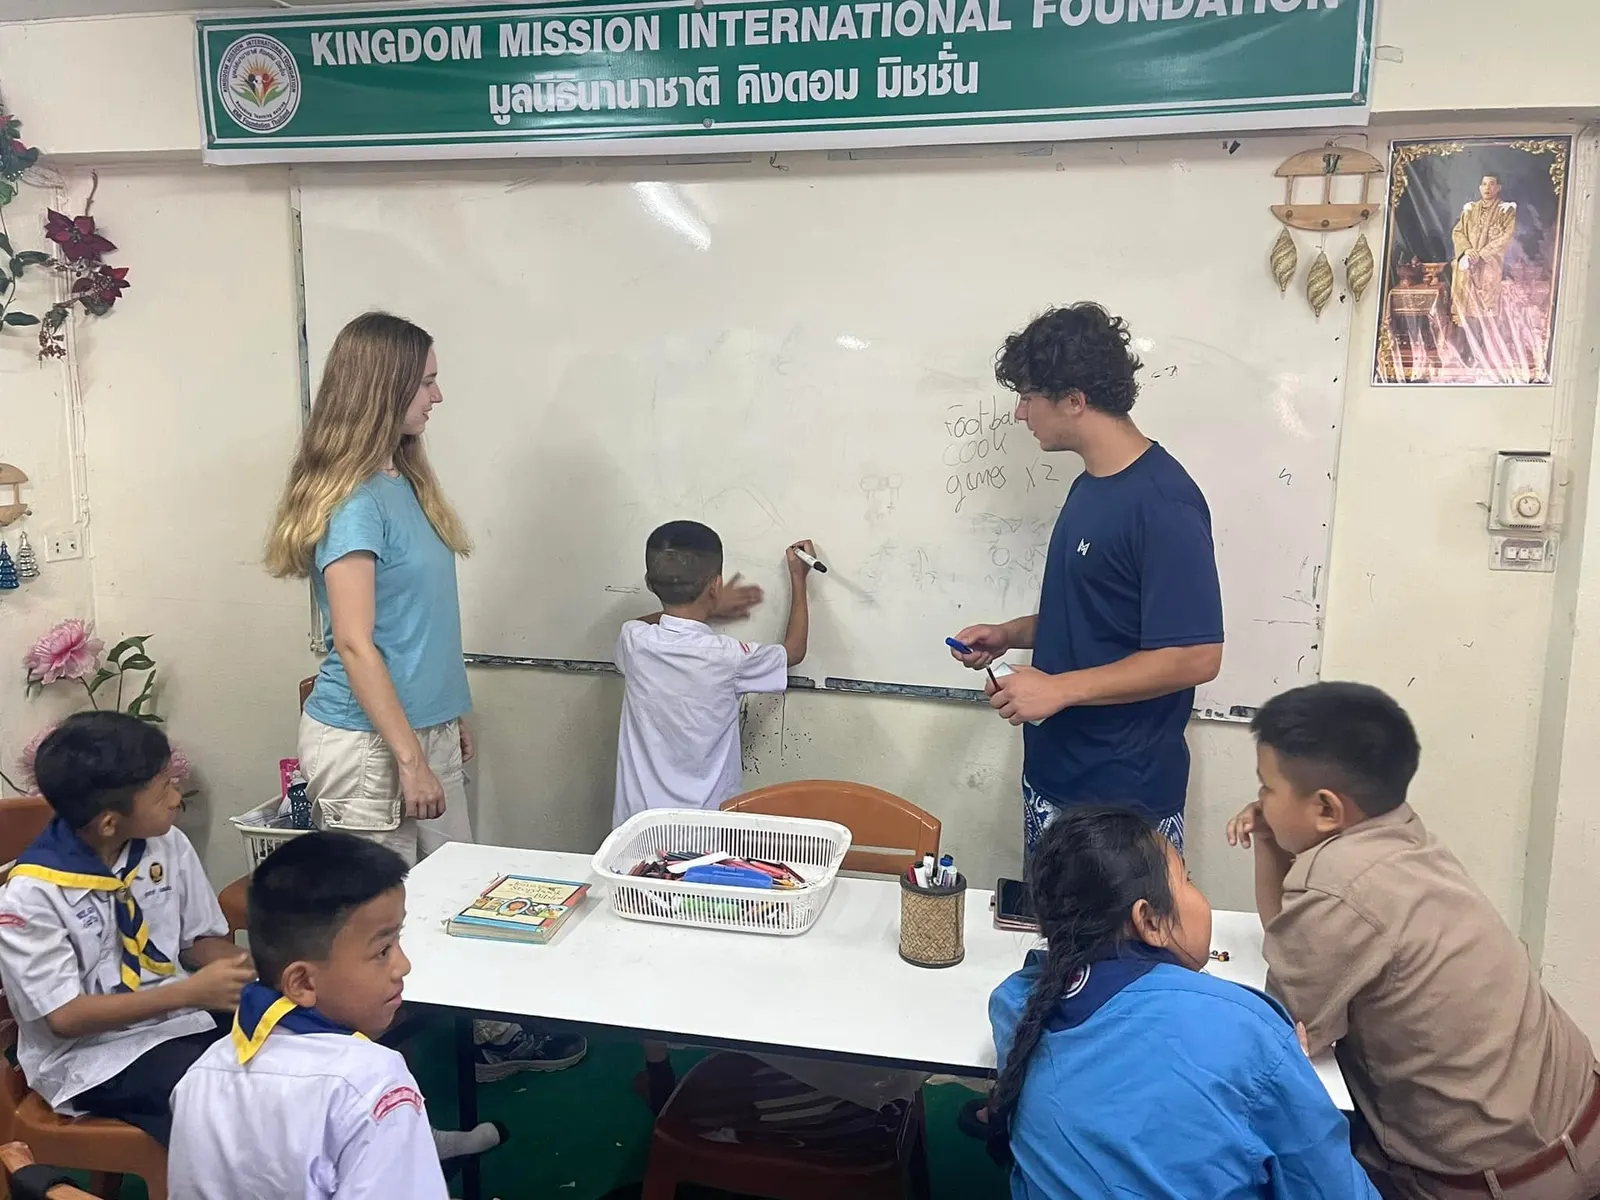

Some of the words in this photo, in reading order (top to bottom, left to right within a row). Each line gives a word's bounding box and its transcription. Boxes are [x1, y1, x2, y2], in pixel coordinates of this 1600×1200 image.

[310, 25, 482, 66] KINGDOM
[499, 15, 660, 58] MISSION
[678, 0, 1012, 49] INTERNATIONAL
[1032, 0, 1339, 28] FOUNDA
[489, 66, 720, 126] มูลนิธินานาชาติ
[737, 64, 859, 105] คิงดอม
[877, 41, 979, 98] มิชชั่น
[942, 429, 1007, 467] cook
[946, 465, 1006, 513] games
